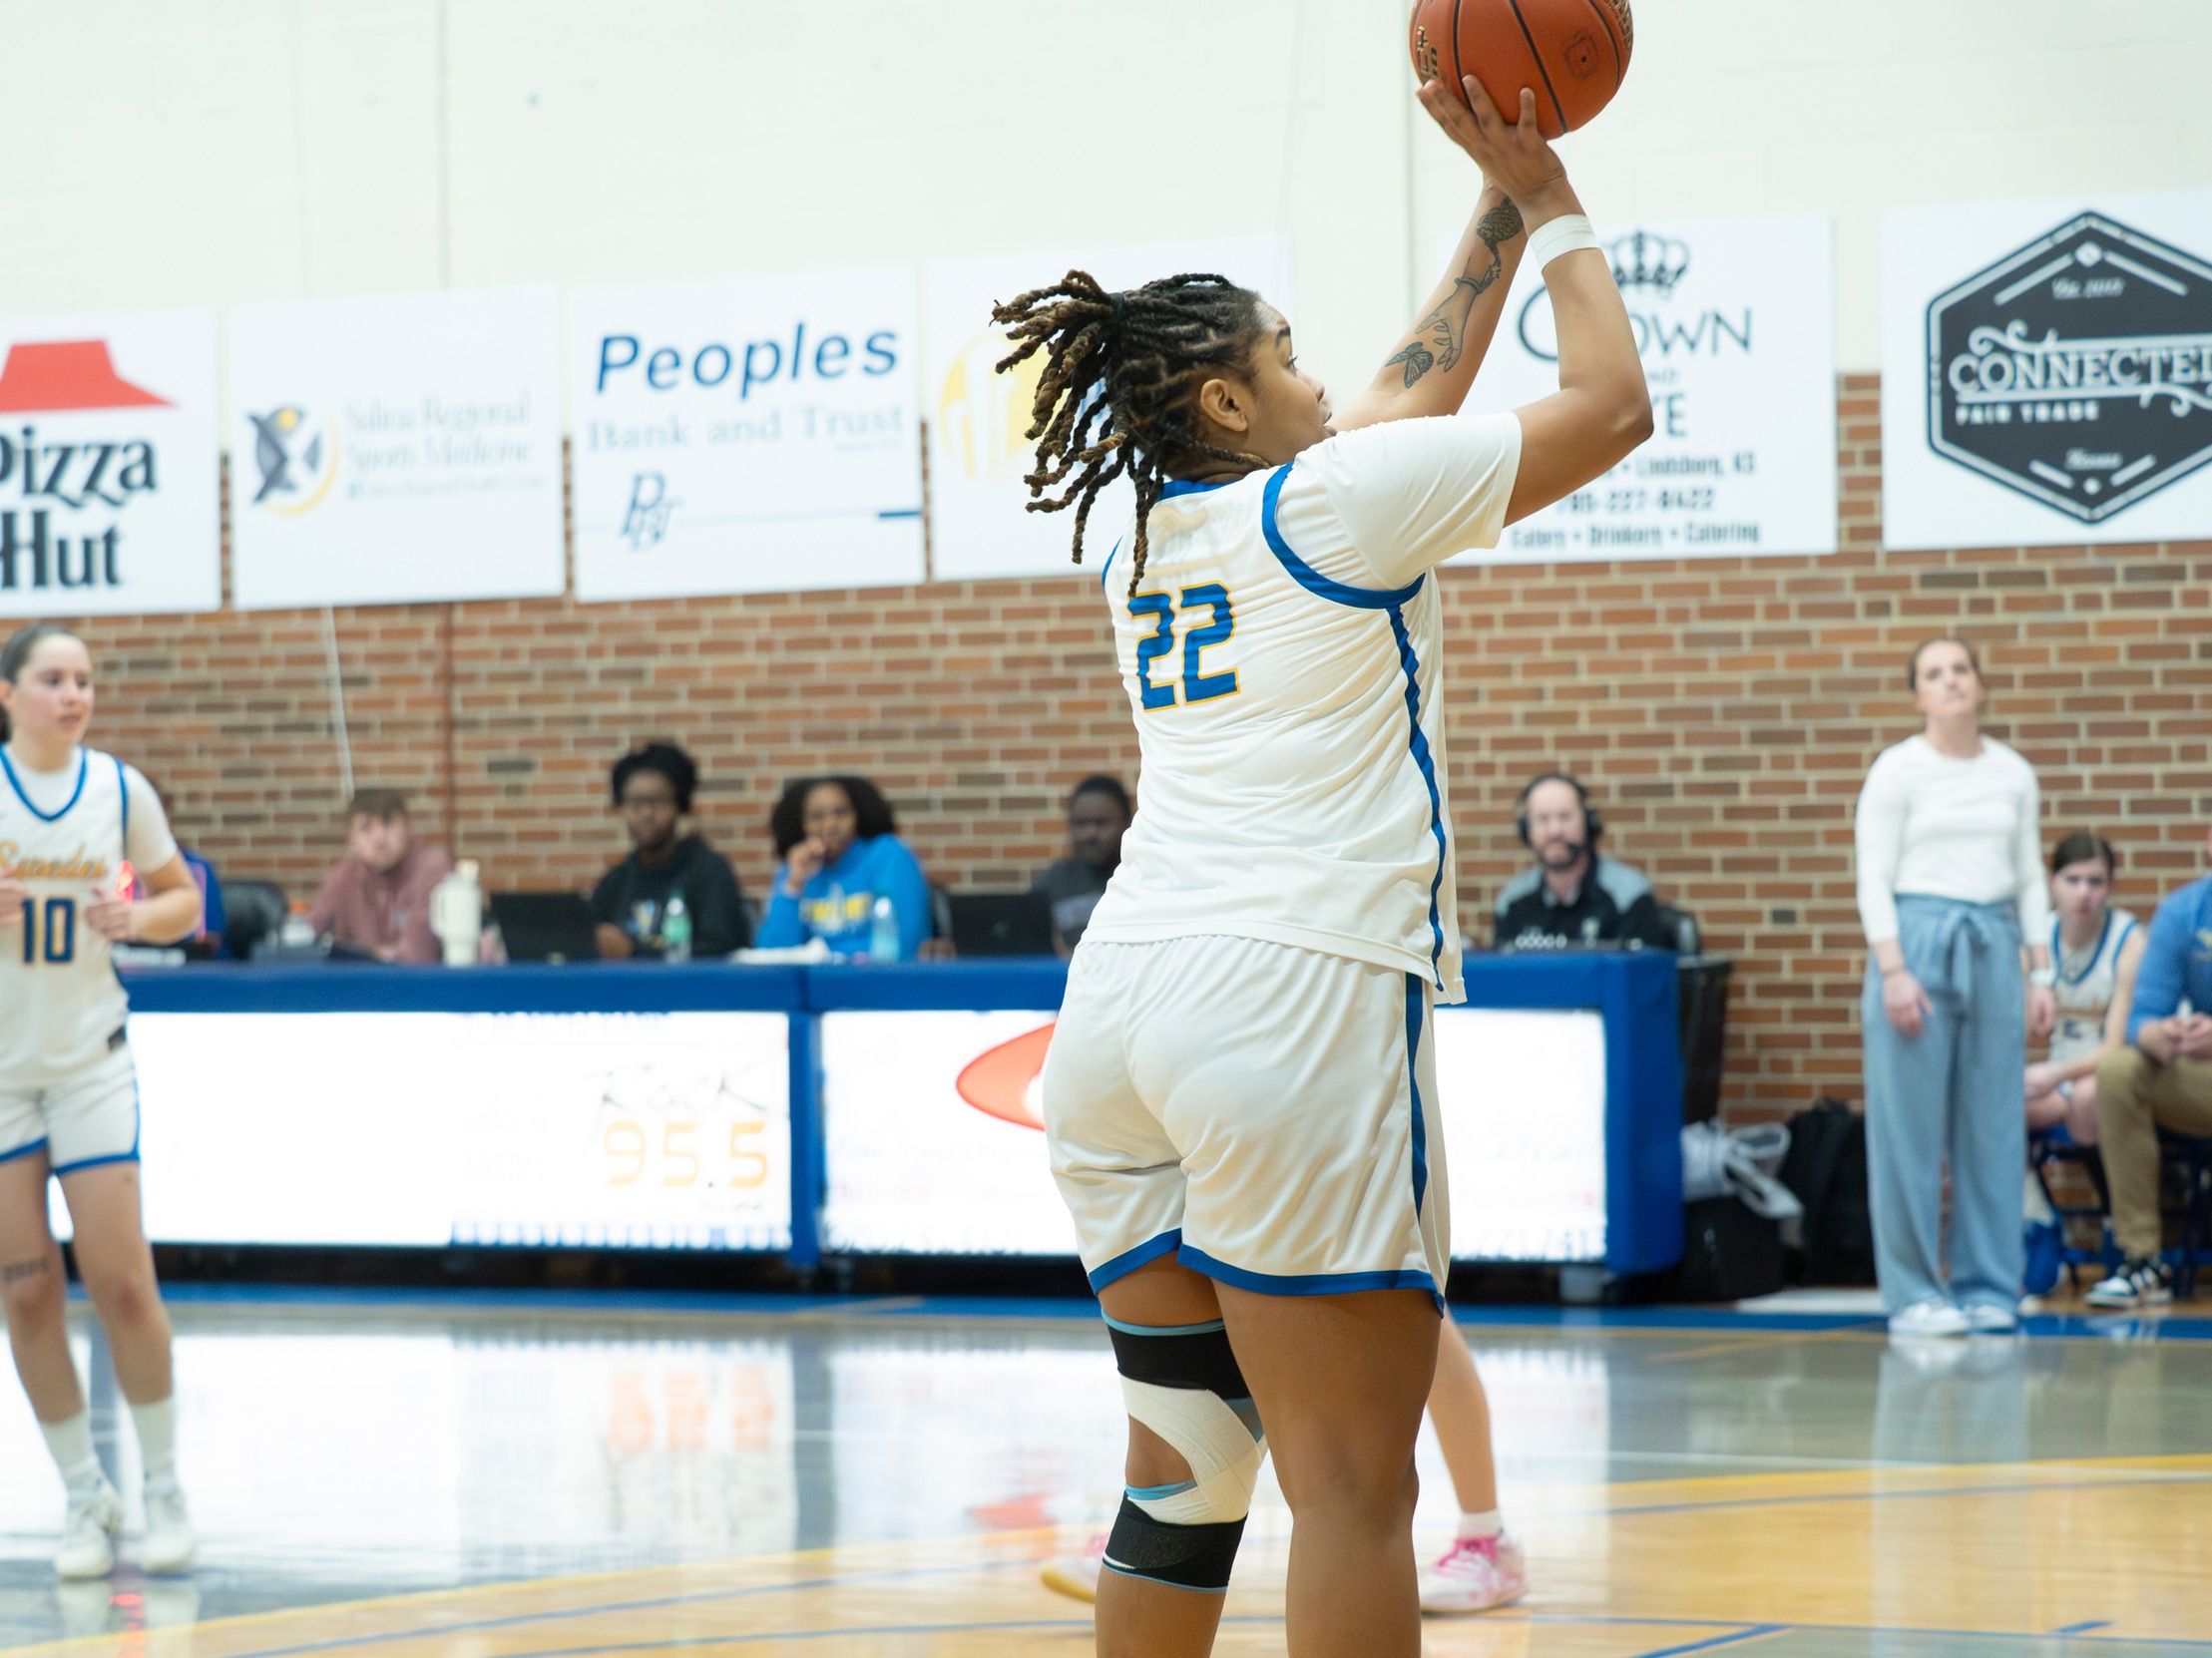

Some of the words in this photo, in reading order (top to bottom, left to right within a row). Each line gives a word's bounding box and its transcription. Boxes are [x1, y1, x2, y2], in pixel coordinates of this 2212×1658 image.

[595, 321, 901, 400] Peoples
[587, 417, 690, 452] Bank
[707, 410, 783, 445] and
[796, 403, 903, 440] Trust
[2018, 399, 2098, 423] TRADE
[0, 510, 122, 589] Hut
[1125, 580, 1241, 712] 22
[20, 894, 79, 965] 10
[602, 1120, 768, 1189] 95.5
